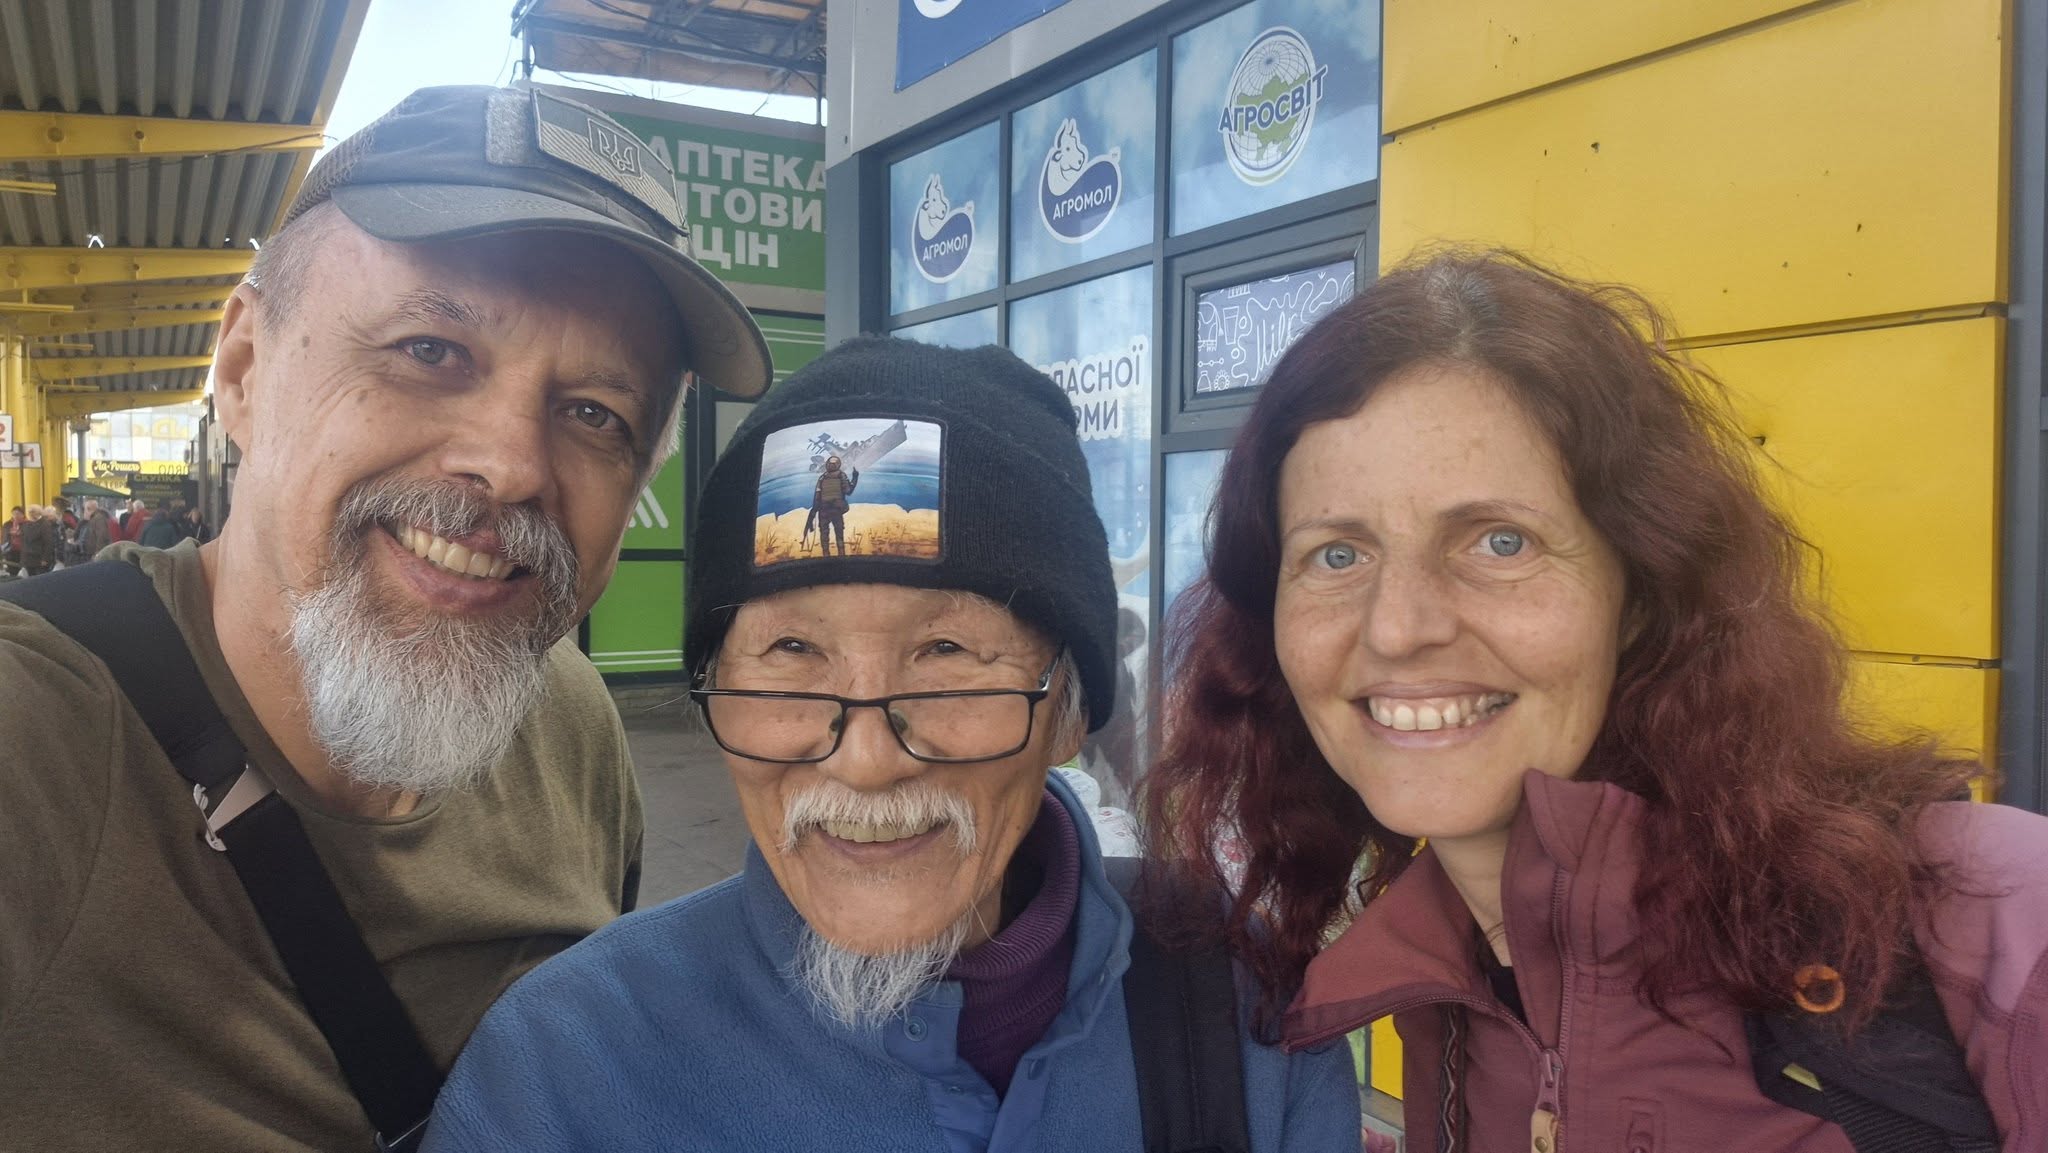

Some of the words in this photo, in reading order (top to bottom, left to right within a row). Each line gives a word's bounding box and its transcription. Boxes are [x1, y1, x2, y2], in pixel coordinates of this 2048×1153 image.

[1219, 66, 1328, 132] АГРОСВІТ
[674, 180, 826, 233] ТОВИ
[1053, 184, 1113, 221] АГРОМОЛ
[691, 223, 779, 270] ЦІН
[922, 233, 968, 262] АГРОМОЛ
[1053, 343, 1144, 395] ЛАСНОЇ
